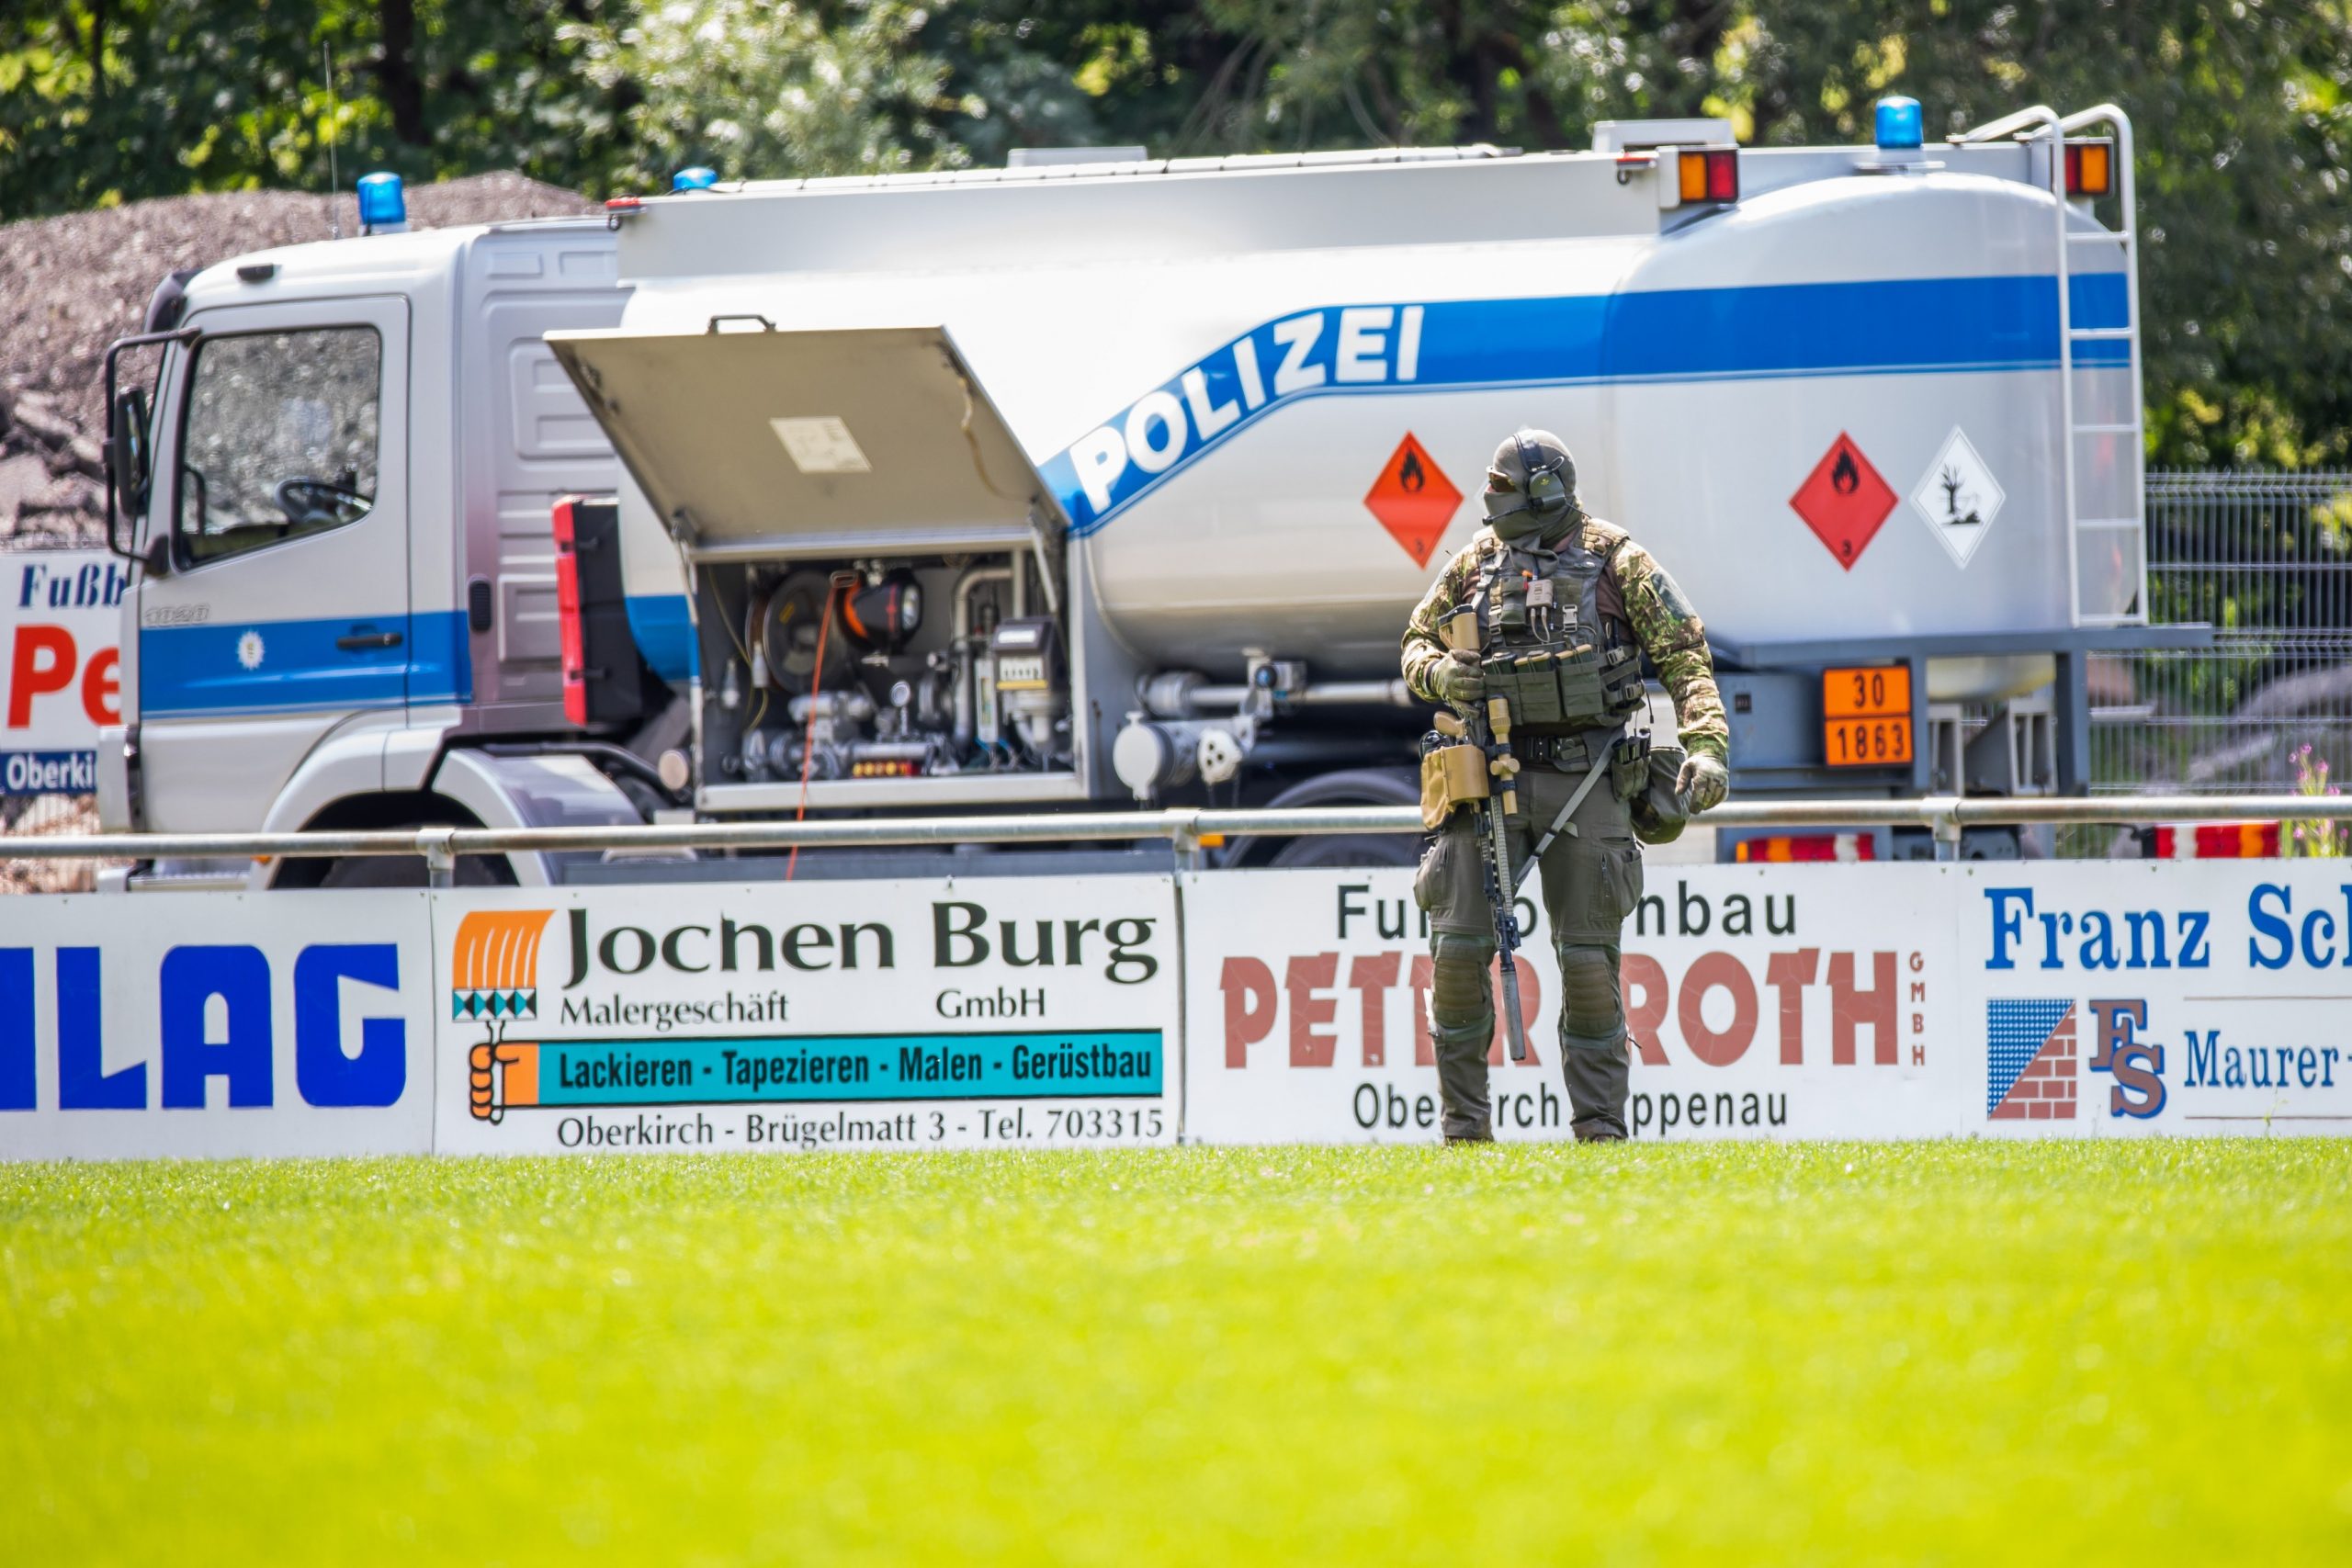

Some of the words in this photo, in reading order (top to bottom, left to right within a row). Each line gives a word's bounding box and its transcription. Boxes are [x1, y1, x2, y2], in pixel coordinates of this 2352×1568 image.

[1069, 304, 1425, 514] POLIZEI
[1853, 672, 1885, 708] 30
[1837, 723, 1905, 759] 1863
[1338, 880, 1796, 939] Fuonbau
[1983, 886, 2211, 971] Franz
[561, 908, 895, 990] Jochen
[932, 901, 1159, 986] Burg
[560, 992, 790, 1032] Malergeschäft
[935, 987, 1046, 1018] GmbH
[1619, 947, 1898, 1066] ROTH
[1908, 951, 1927, 1066] GMBH
[560, 1052, 693, 1090] Lackieren
[721, 1048, 869, 1093] Tapezieren
[899, 1045, 982, 1082] Malen
[1012, 1043, 1151, 1081] Gerüstbau
[2184, 1029, 2352, 1089] Maurer
[557, 1112, 713, 1147] Oberkirch
[747, 1111, 916, 1148] Brügelmatt
[929, 1111, 944, 1140] 3
[979, 1107, 1033, 1140] Tel.
[1046, 1108, 1163, 1138] 703315
[1353, 1082, 1559, 1130] Oberch
[1632, 1090, 1787, 1136] ppenau
